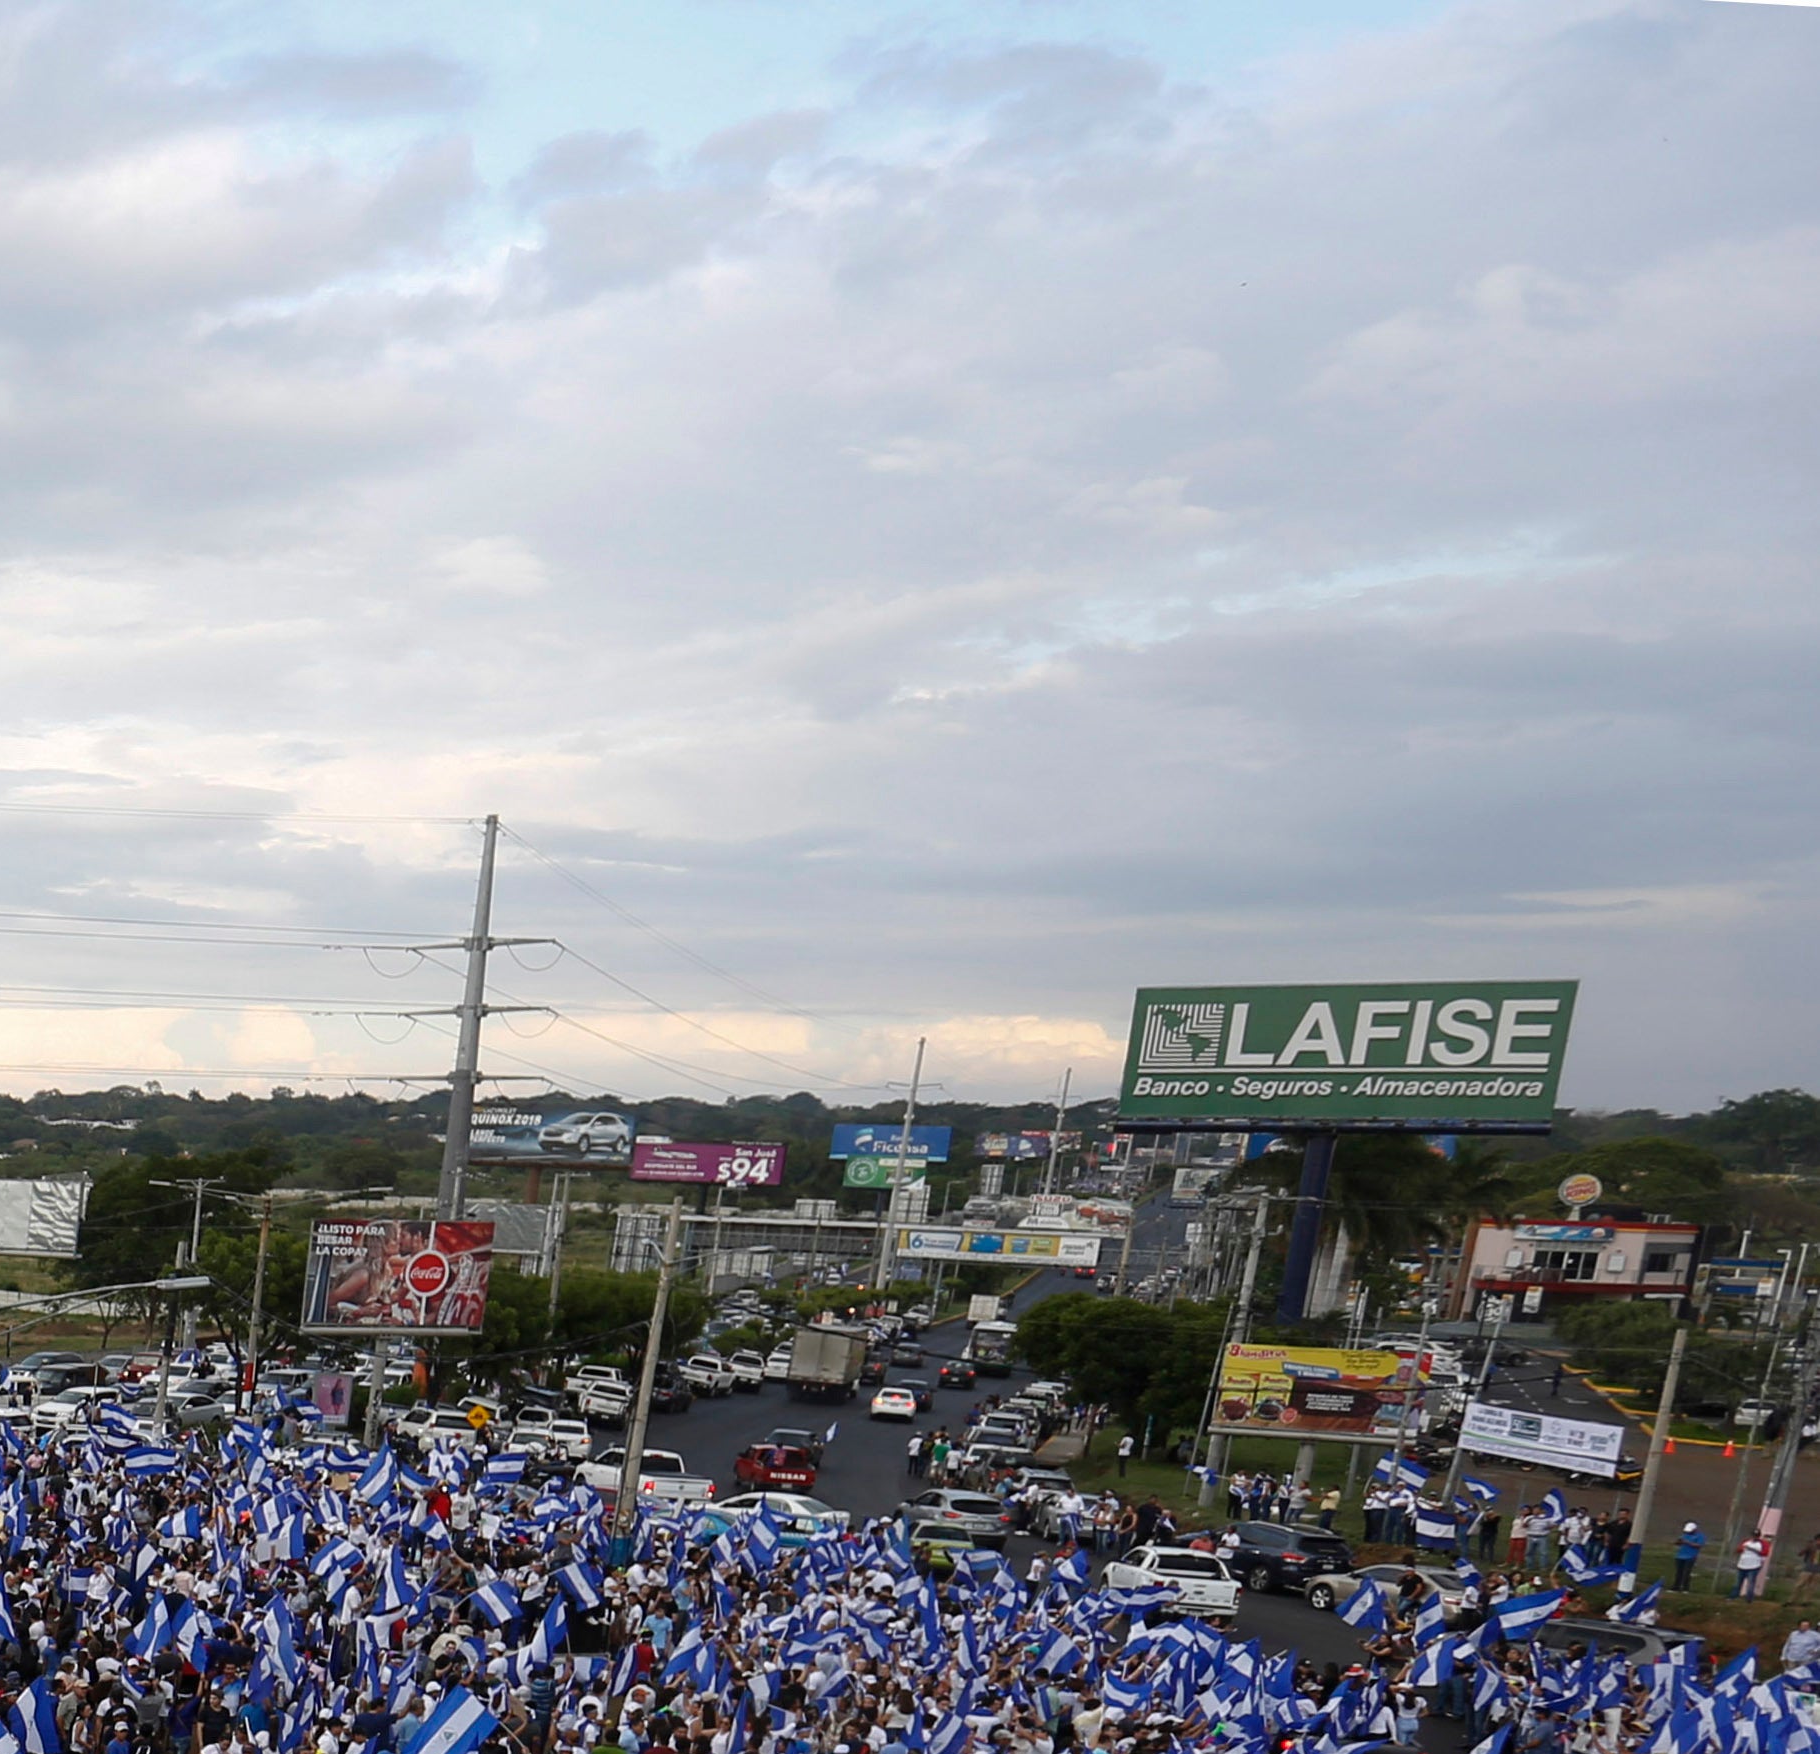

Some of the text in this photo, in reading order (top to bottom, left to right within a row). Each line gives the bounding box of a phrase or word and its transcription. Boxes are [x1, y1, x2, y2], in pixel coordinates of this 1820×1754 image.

[1224, 997, 1561, 1067] LAFISE
[1132, 1075, 1544, 1101] Banco Seguros Almacenadora
[514, 1115, 543, 1127] 2018
[735, 1147, 753, 1158] San
[718, 1158, 770, 1184] $94
[318, 1223, 386, 1236] ¿LISTO PARA
[317, 1236, 353, 1245] BESAR
[316, 1246, 368, 1257] LA COPA?
[410, 1266, 444, 1280] Coca-Cola
[770, 1472, 807, 1481] NISSAN
